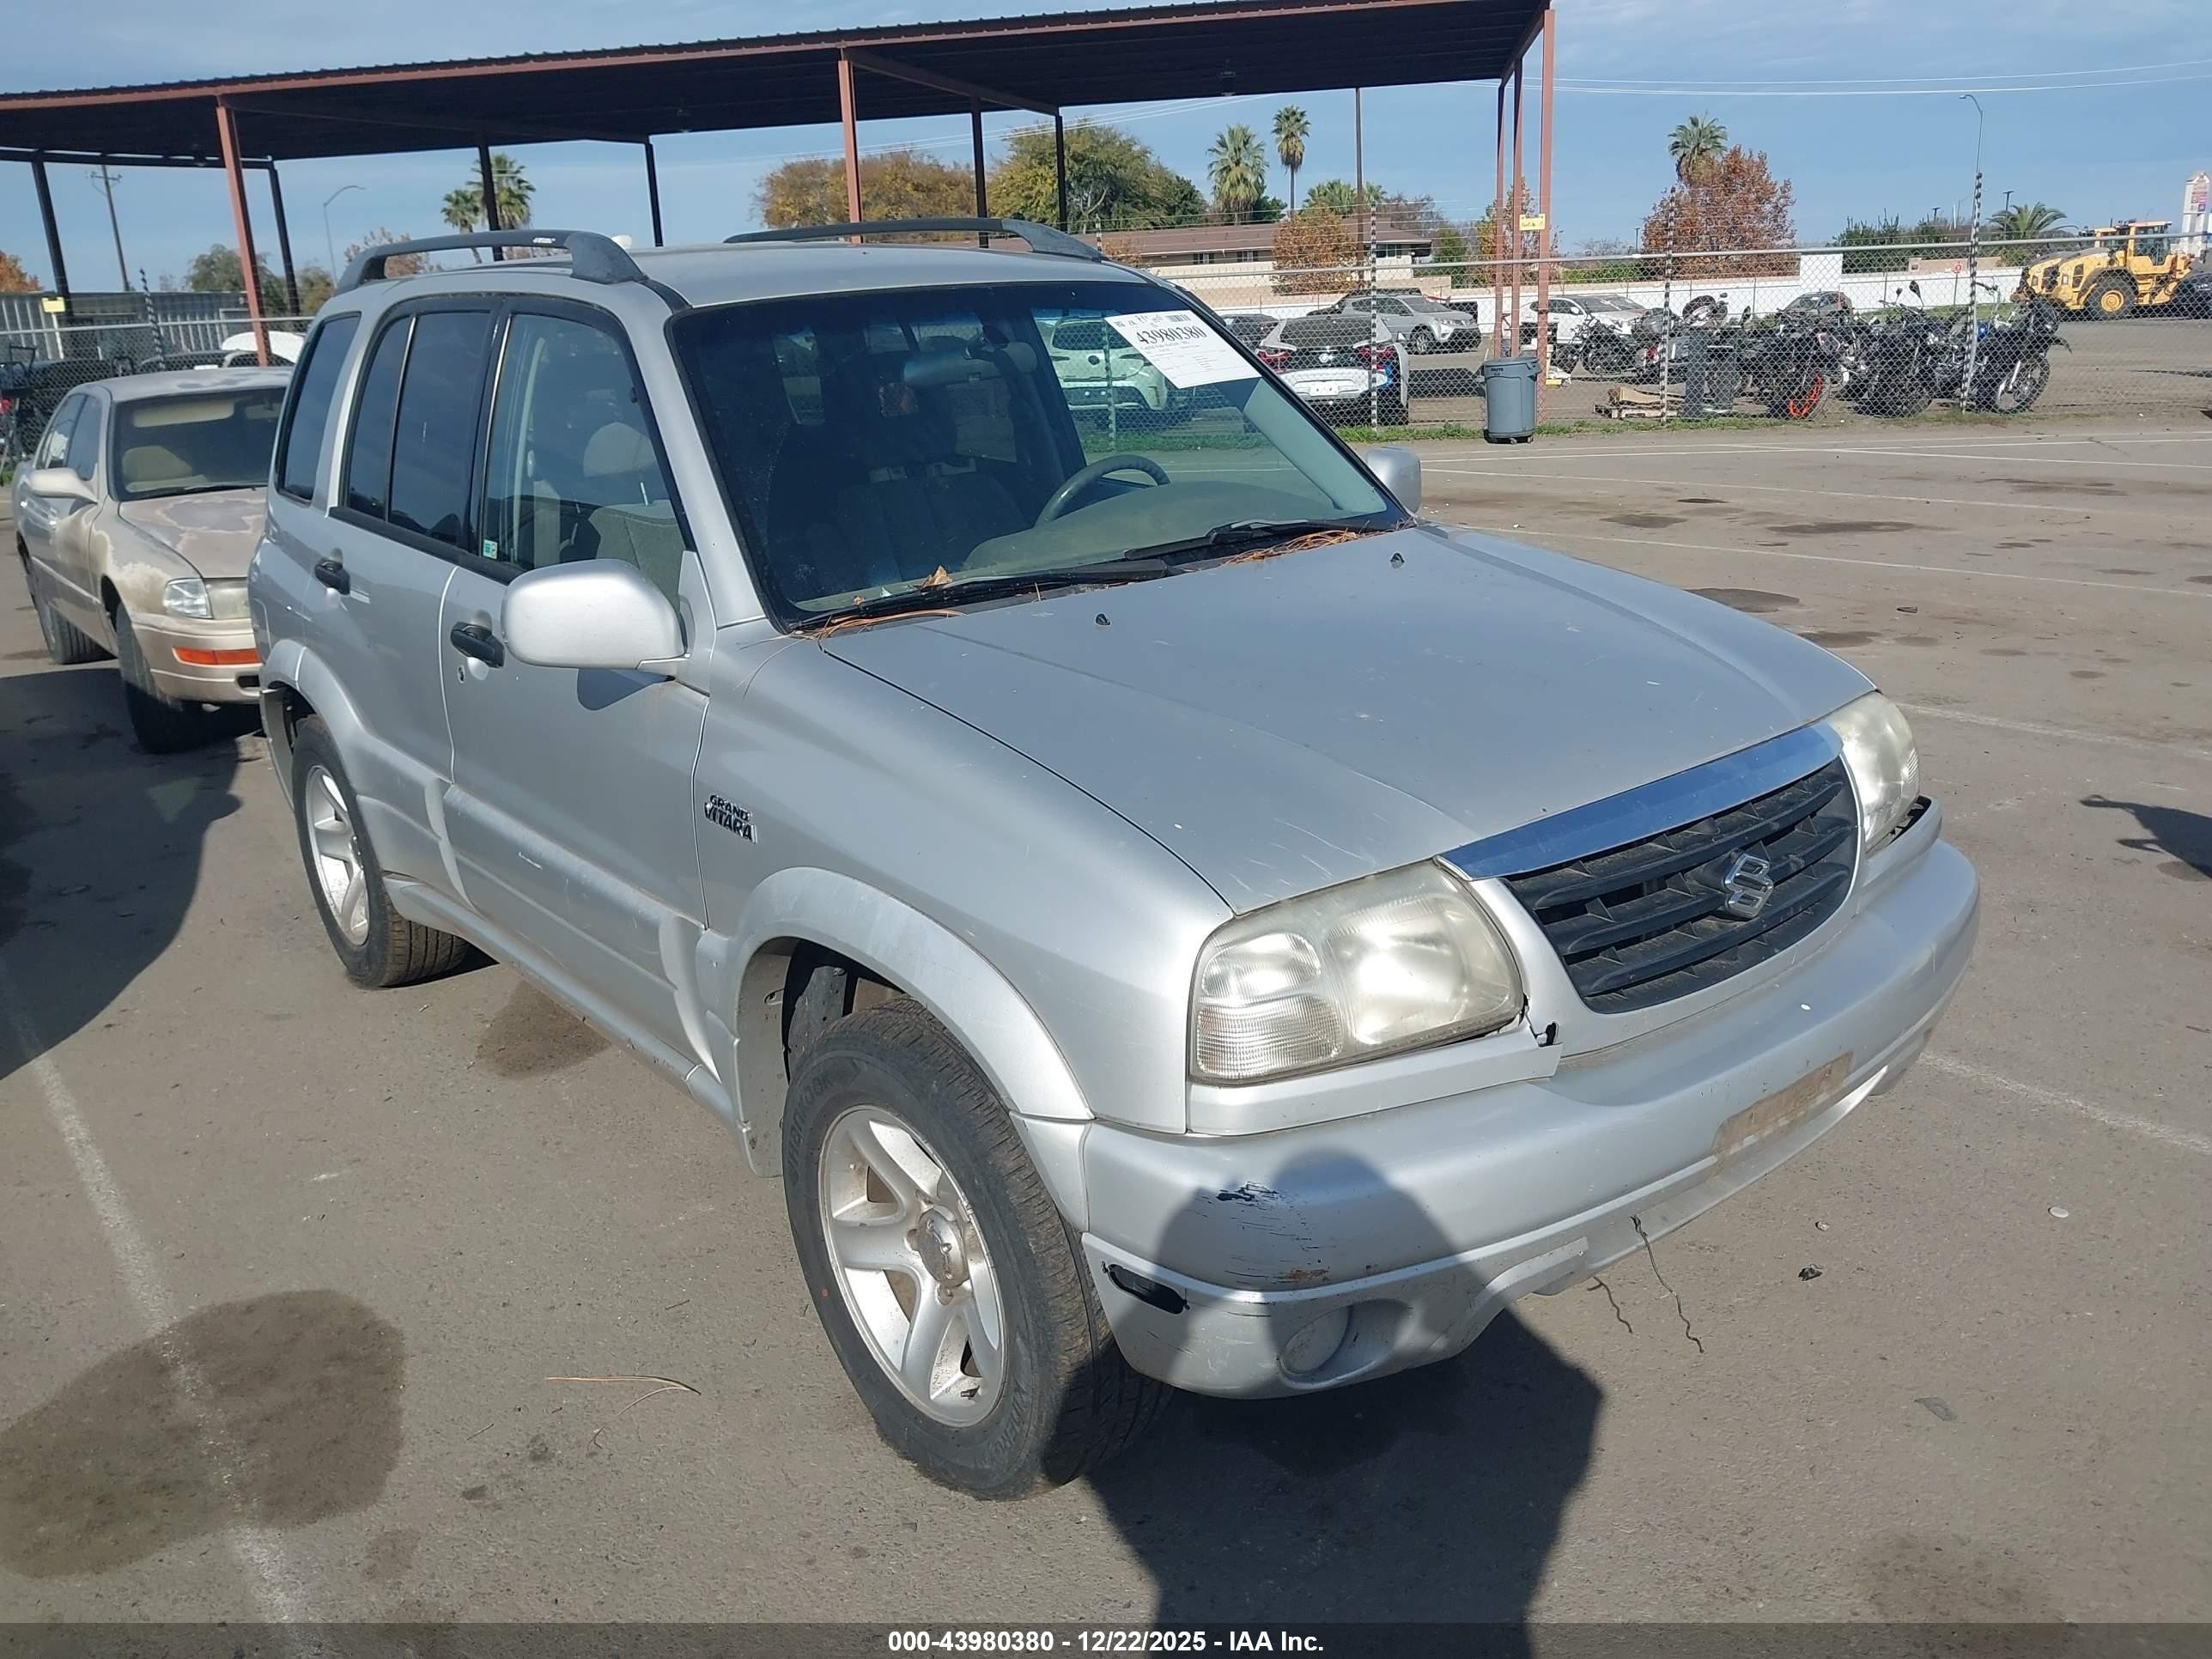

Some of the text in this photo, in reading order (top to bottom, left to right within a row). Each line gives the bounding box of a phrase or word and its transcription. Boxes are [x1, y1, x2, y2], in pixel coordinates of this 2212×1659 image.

[1136, 325, 1207, 344] 43980380
[704, 802, 756, 842] VITARA
[709, 794, 751, 822] GRAND
